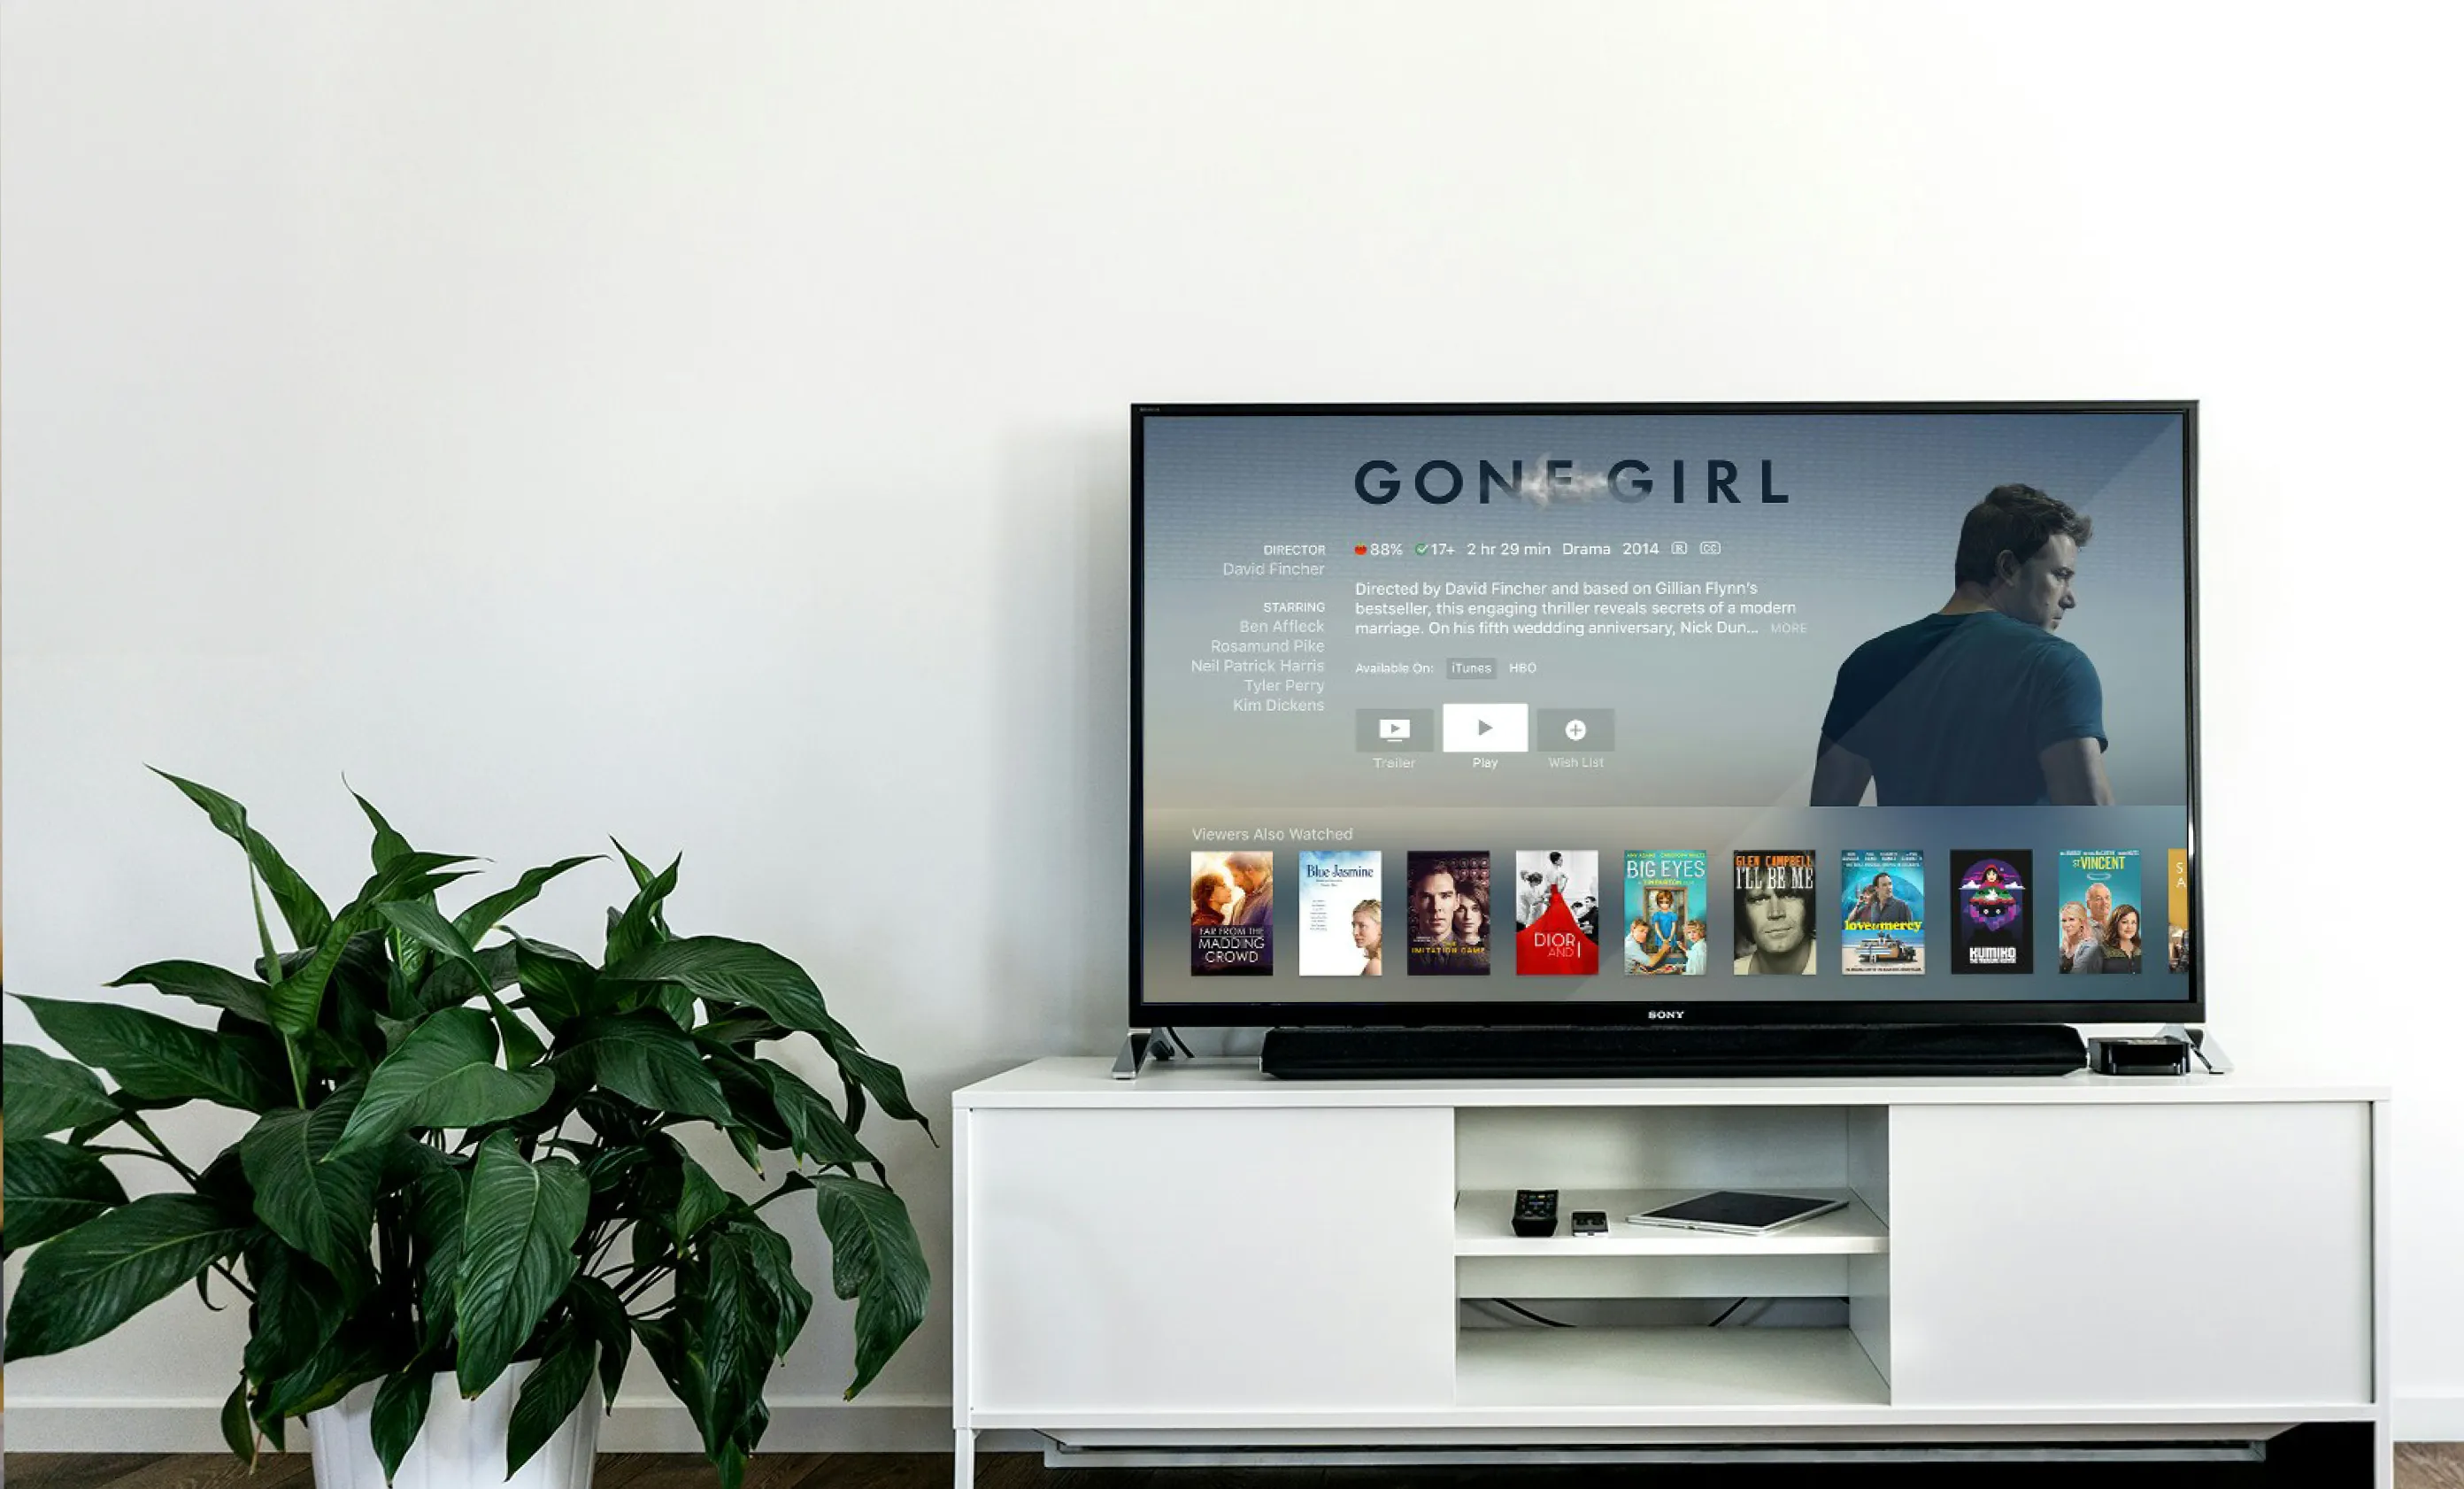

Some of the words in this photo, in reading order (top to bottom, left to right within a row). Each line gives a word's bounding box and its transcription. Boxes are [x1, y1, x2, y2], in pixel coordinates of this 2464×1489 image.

[1355, 459, 1573, 505] GONE
[1607, 459, 1790, 504] GIRL
[1263, 544, 1327, 556] DIRECTOR
[1370, 543, 1404, 556] 88%
[1430, 543, 1456, 556] 17+
[1467, 543, 1476, 555] 2
[1481, 543, 1497, 555] hr
[1501, 543, 1520, 555] 29
[1524, 543, 1551, 555] min
[1563, 543, 1611, 555] Drama
[1622, 543, 1659, 555] 2014
[1223, 562, 1265, 575] David
[1269, 562, 1325, 575] Fincher
[1355, 582, 1420, 596] Directed
[1422, 582, 1442, 598] by
[1445, 582, 1488, 596] David
[1491, 582, 1547, 596] Fincher
[1552, 582, 1579, 595] and
[1583, 582, 1629, 595] based
[1632, 585, 1652, 595] on
[1655, 582, 1701, 595] Gillian
[1706, 582, 1759, 598] Flynn's
[1263, 602, 1326, 613] STARRING
[1355, 602, 1432, 617] bestseller,
[1436, 602, 1464, 615] this
[1467, 603, 1537, 618] engaging
[1542, 602, 1590, 615] thriller
[1593, 602, 1647, 614] reveals
[1652, 603, 1706, 614] secrets
[1709, 602, 1725, 614] of
[1728, 605, 1736, 614] a
[1740, 602, 1797, 614] modern
[1240, 620, 1268, 633] Ben
[1272, 619, 1325, 633] Affleck
[1355, 621, 1424, 636] marriage.
[1428, 621, 1451, 634] On
[1453, 621, 1475, 634] his
[1478, 621, 1509, 634] fifth
[1512, 621, 1584, 636] weddding
[1589, 621, 1675, 636] anniversary,
[1680, 621, 1713, 634] Nick
[1771, 622, 1808, 634] MORE
[1211, 639, 1290, 652] Rosamund
[1293, 639, 1325, 652] Pike
[1191, 660, 1220, 672] Neil
[1224, 659, 1275, 672] Patrick
[1281, 659, 1325, 672] Harris
[1355, 662, 1409, 674] Available
[1412, 662, 1434, 674] On:
[1451, 661, 1492, 674] iTunes
[1508, 663, 1536, 674] HBO
[1244, 678, 1282, 694] Tyler
[1285, 679, 1325, 694] Perry
[1233, 698, 1261, 711] Kim
[1266, 698, 1324, 711] Dickens
[1372, 757, 1416, 768] Trailer
[1472, 757, 1498, 770] Play
[1548, 757, 1579, 768] Wish
[1582, 757, 1605, 768] List
[1192, 827, 1249, 841] Viewers
[1253, 827, 1284, 841] Also
[1289, 827, 1354, 841] Watched
[1736, 855, 1760, 867] GLEN
[2080, 856, 2126, 870] VINCENT
[1306, 864, 1330, 877] Blue
[1332, 864, 1374, 878] Jasmine
[1627, 860, 1656, 878] BIG
[1661, 860, 1706, 878] EYES
[1736, 866, 1762, 890] I'LL
[1767, 866, 1786, 890] BE
[1790, 866, 1813, 890] ME
[1198, 937, 1265, 949] MADDING
[1534, 932, 1576, 947] DIOR
[1205, 951, 1259, 963] CROWD
[1547, 946, 1574, 958] AND
[1969, 946, 2016, 959] KUMIKO
[1647, 1009, 1684, 1020] SONY
